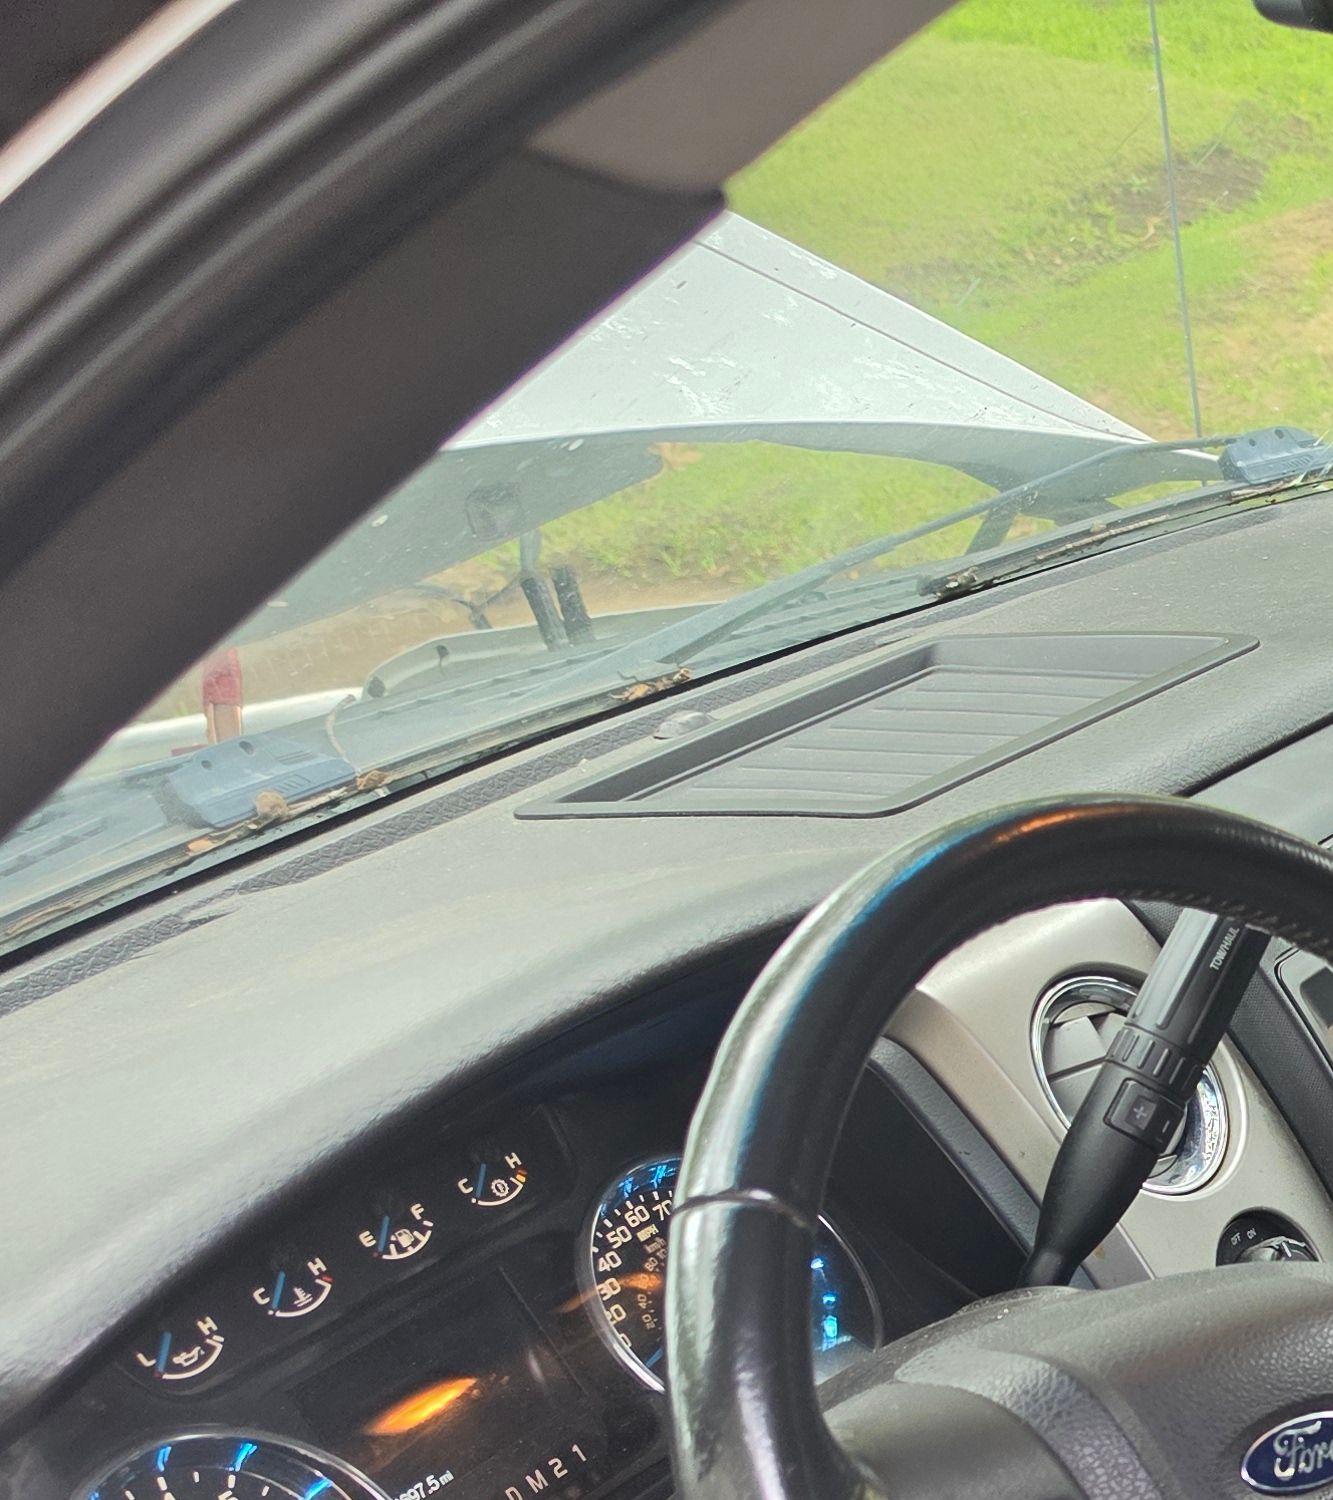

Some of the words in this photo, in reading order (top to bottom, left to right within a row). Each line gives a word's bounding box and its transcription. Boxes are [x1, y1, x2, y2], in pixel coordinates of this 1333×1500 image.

[1209, 926, 1240, 970] TOW/HAUL
[504, 1152, 522, 1169] H
[457, 1177, 474, 1194] C
[410, 1203, 425, 1220] F
[624, 1205, 650, 1228] 60
[358, 1230, 377, 1248] E
[606, 1225, 632, 1249] 50
[307, 1257, 327, 1276] H
[598, 1250, 622, 1272] 40
[252, 1287, 271, 1305] C
[596, 1277, 621, 1301] 30
[197, 1316, 218, 1336] H
[136, 1352, 156, 1367] L
[525, 1469, 549, 1494] M
[548, 1457, 568, 1479] 2
[571, 1444, 587, 1462] 1
